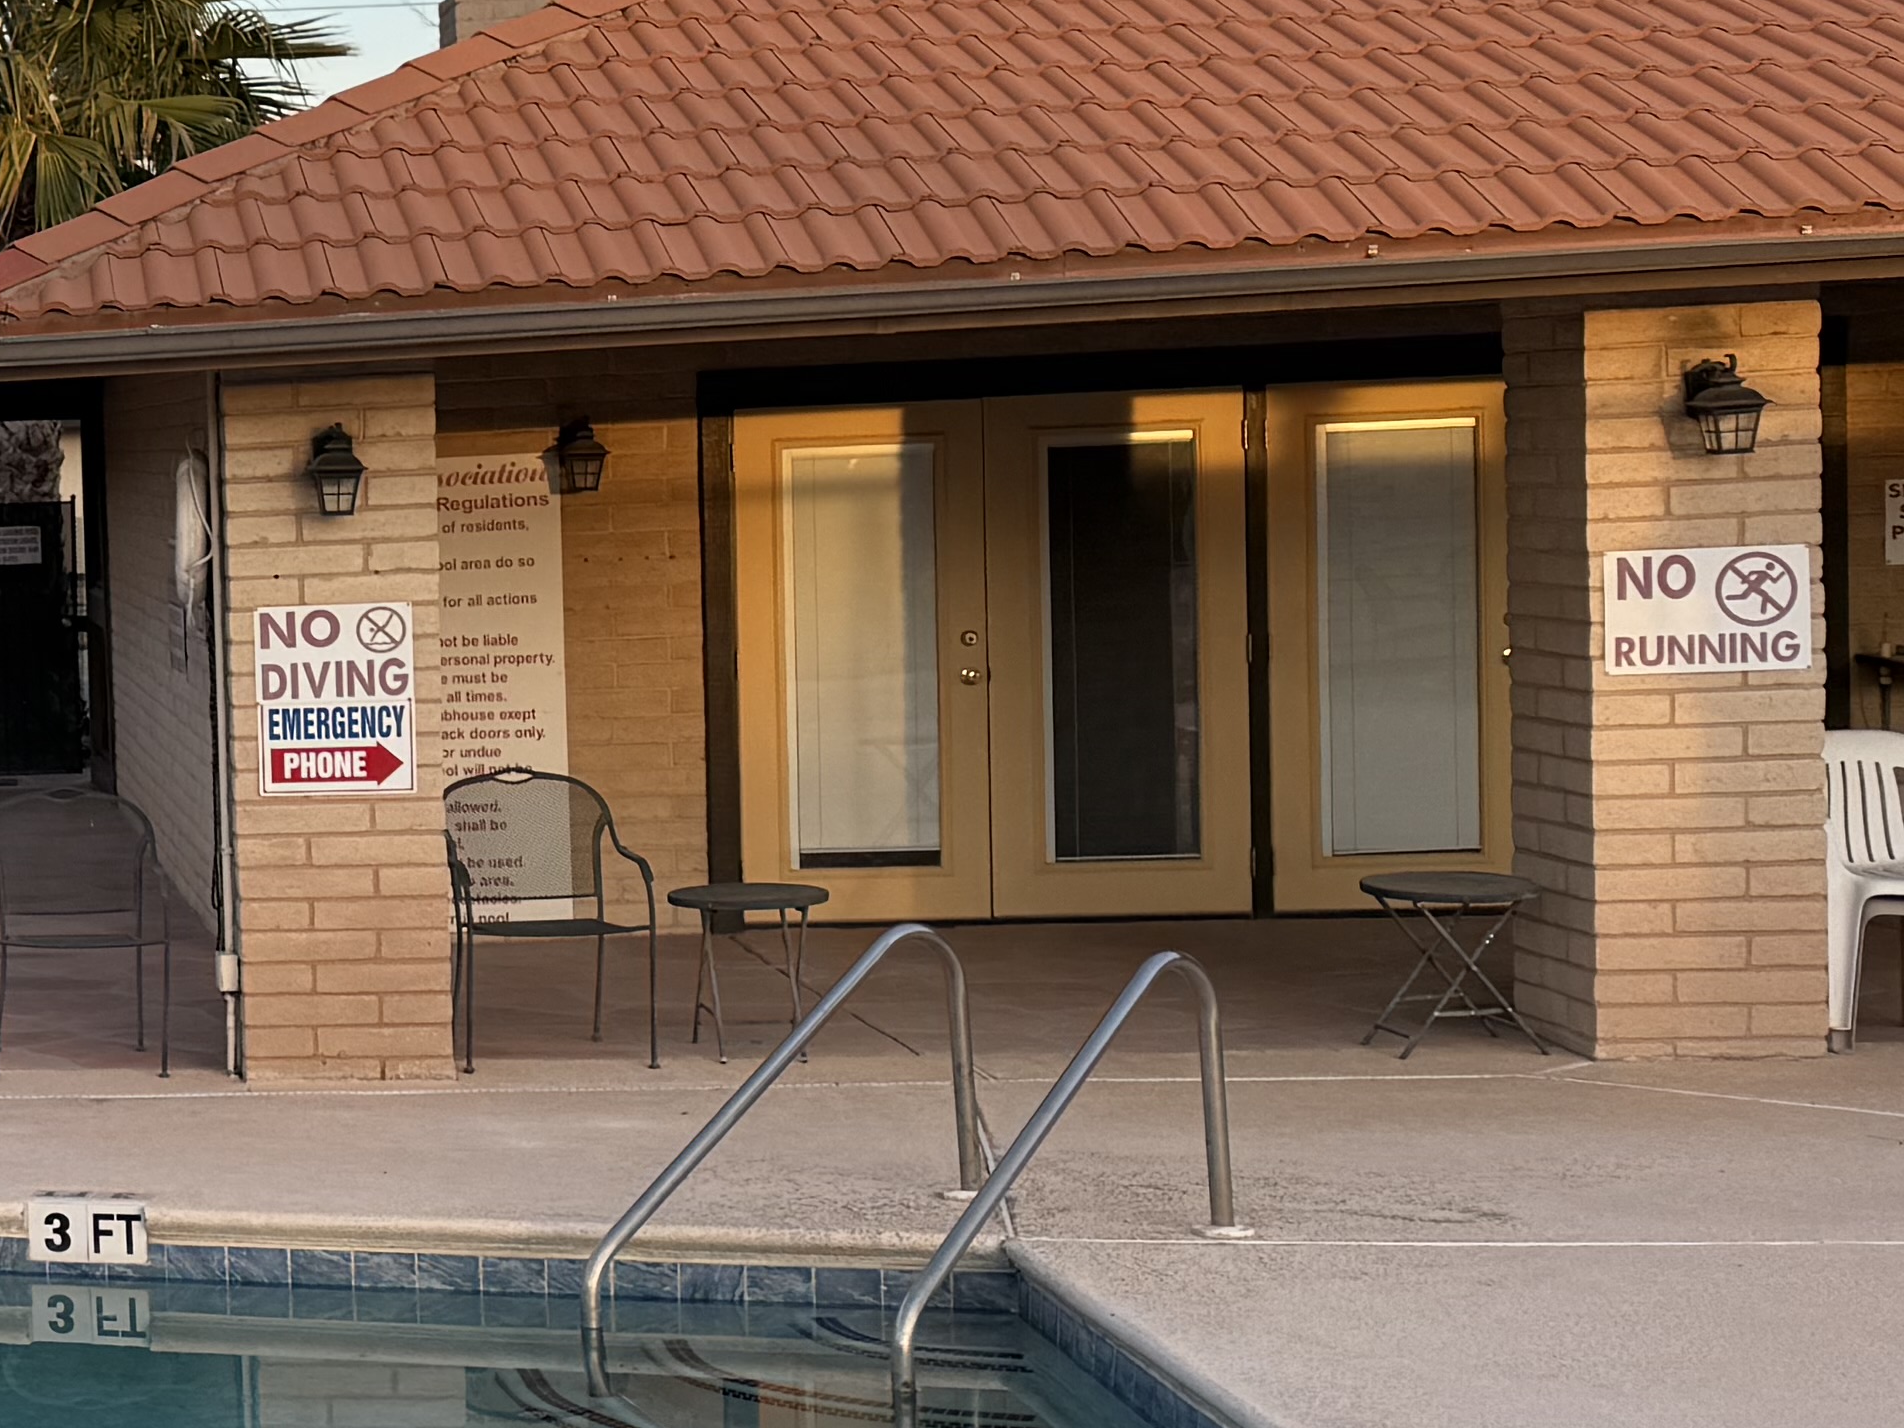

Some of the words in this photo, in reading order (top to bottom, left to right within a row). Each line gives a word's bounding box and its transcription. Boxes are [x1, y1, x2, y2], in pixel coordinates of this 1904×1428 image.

[437, 493, 550, 514] Regulations
[442, 521, 456, 533] of
[461, 559, 491, 570] area
[496, 556, 513, 568] do
[518, 557, 535, 568] so
[1616, 555, 1696, 601] NO
[443, 596, 462, 608] for
[467, 594, 482, 607] all
[487, 593, 537, 606] actions
[259, 610, 340, 649] NO
[462, 635, 479, 647] be
[483, 633, 519, 646] liable
[1615, 631, 1801, 667] RUNNING
[441, 653, 490, 666] ersonal
[493, 653, 555, 668] property.
[261, 658, 409, 700] DIVING
[452, 672, 486, 684] must
[491, 671, 508, 683] be
[447, 691, 461, 703] all
[466, 690, 508, 703] times.
[499, 709, 536, 722] exept
[268, 706, 405, 741] EMERGENCY
[442, 728, 465, 740] ack
[470, 727, 511, 739] doors
[515, 726, 545, 741] only.
[460, 746, 501, 758] undue
[283, 751, 367, 779] PHONE
[463, 764, 485, 775] will
[43, 1213, 71, 1252] 3
[92, 1214, 141, 1255] FT
